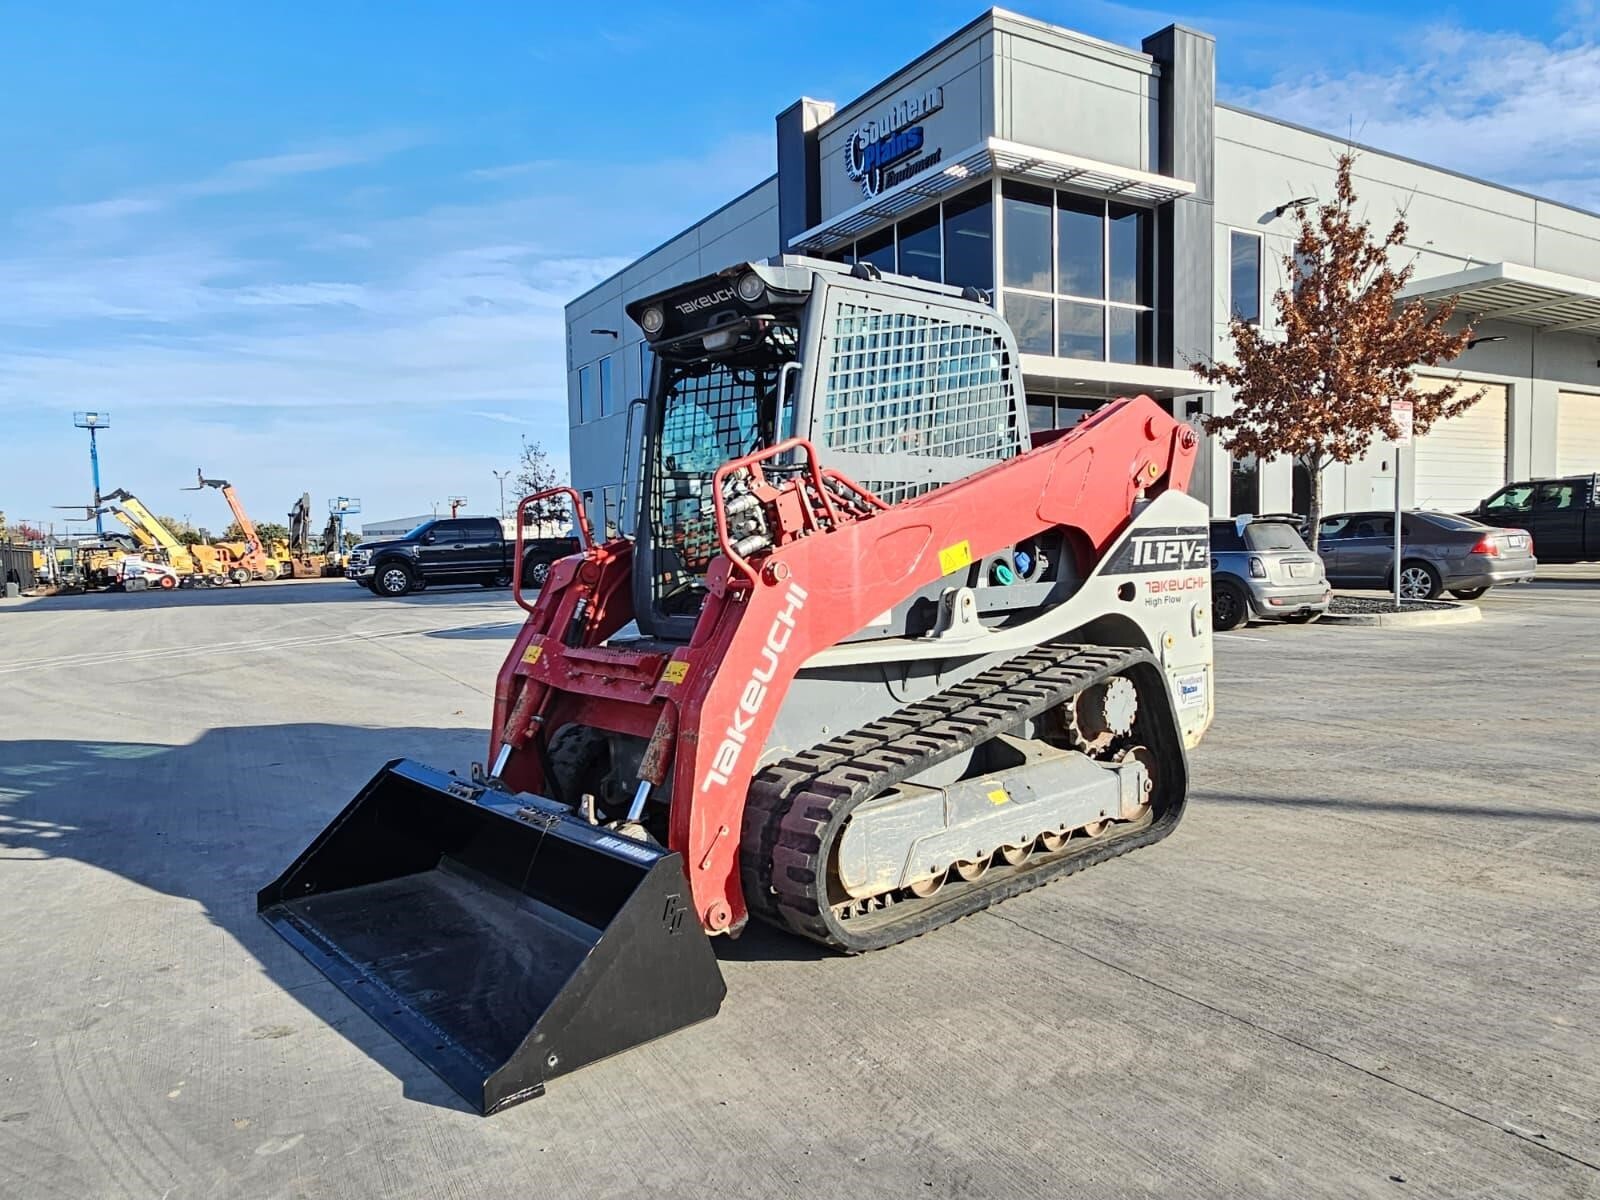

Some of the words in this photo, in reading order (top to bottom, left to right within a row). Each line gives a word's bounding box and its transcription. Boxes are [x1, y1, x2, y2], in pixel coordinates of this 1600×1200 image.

[859, 86, 940, 149] Southern
[864, 128, 921, 173] Plains
[675, 286, 738, 314] TAKEUCH
[1144, 597, 1162, 608] High
[1164, 595, 1182, 605] Flow
